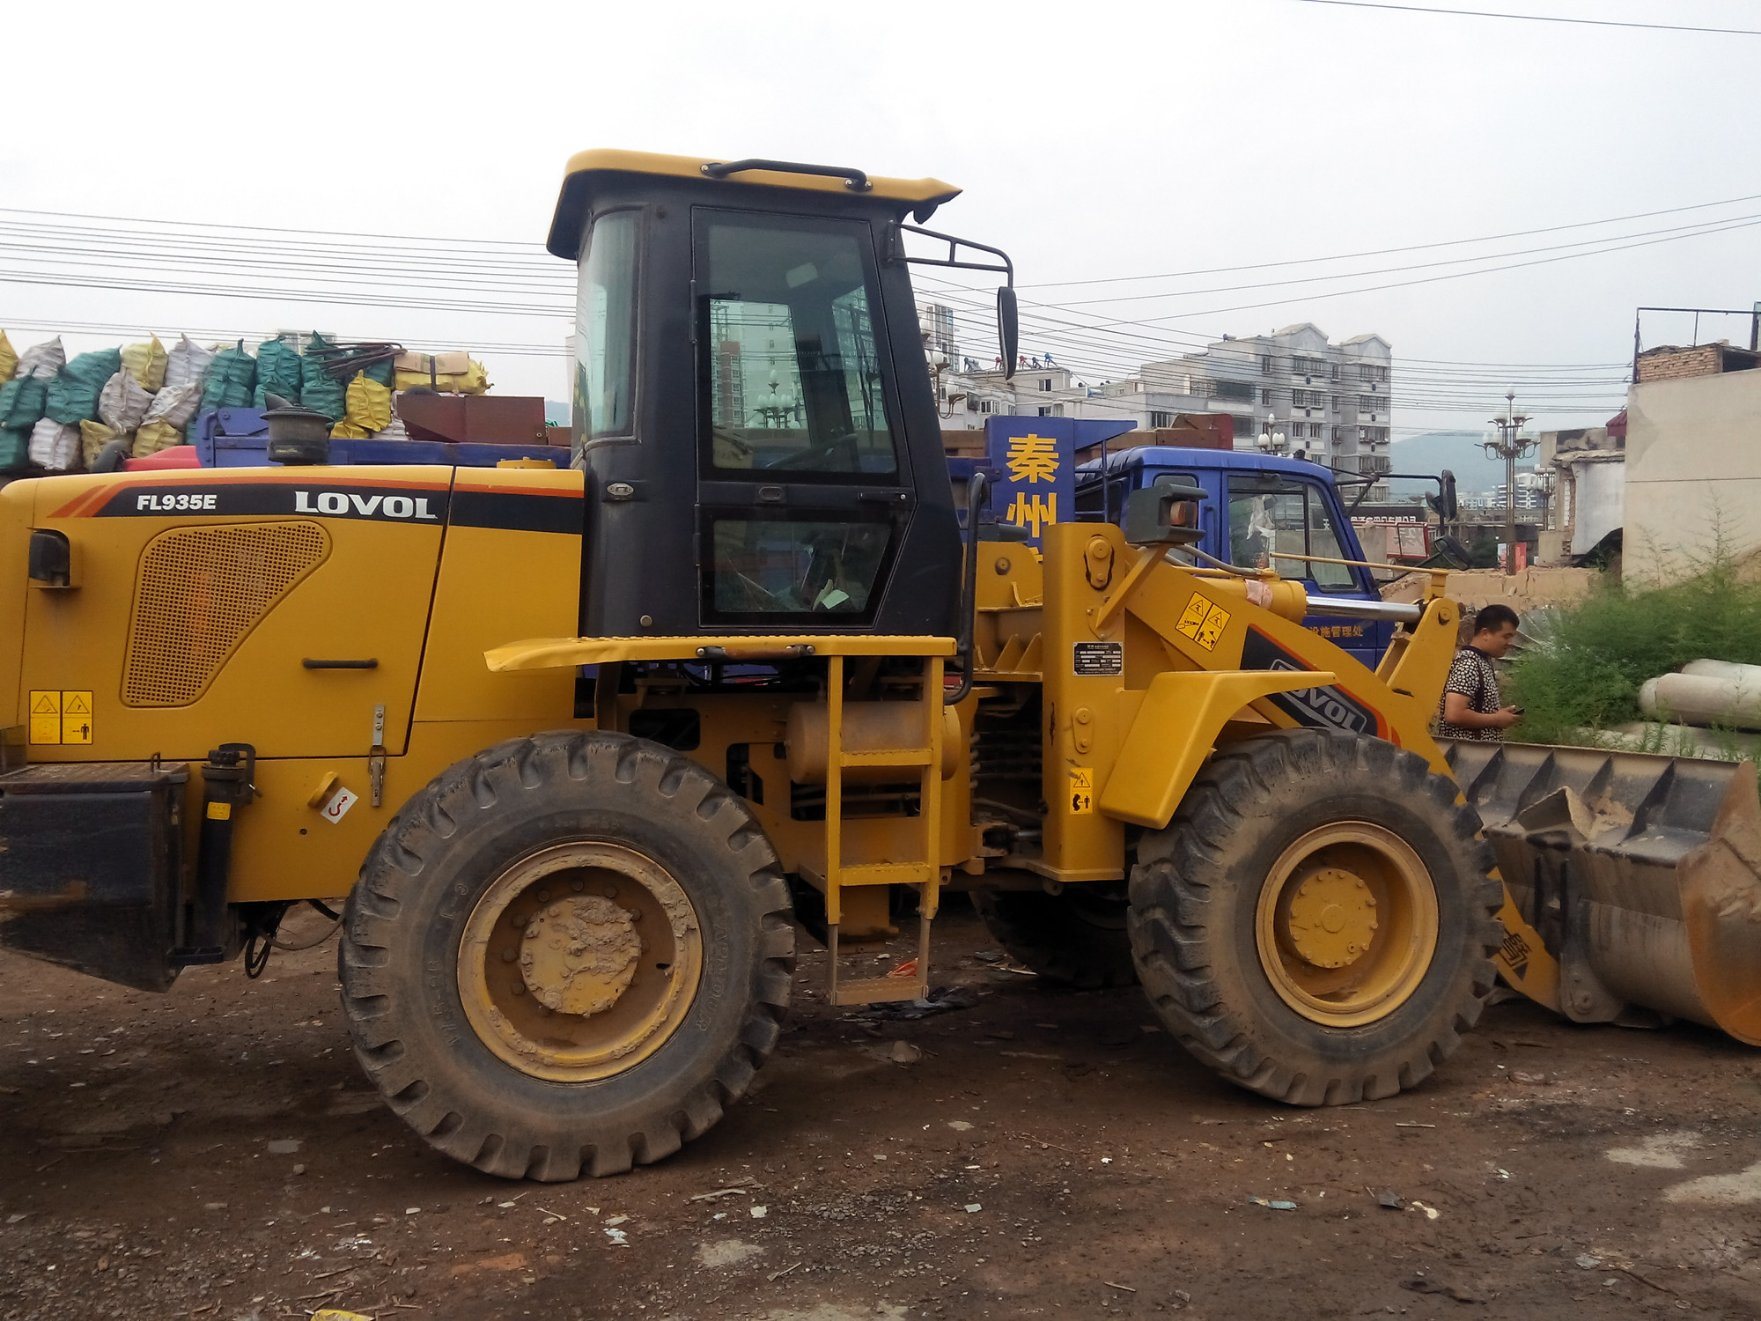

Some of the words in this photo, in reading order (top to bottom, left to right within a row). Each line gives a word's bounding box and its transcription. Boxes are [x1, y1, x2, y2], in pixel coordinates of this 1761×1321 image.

[136, 493, 217, 511] FL935E
[294, 491, 437, 518] LOVOL
[1006, 433, 1059, 564] 秦州
